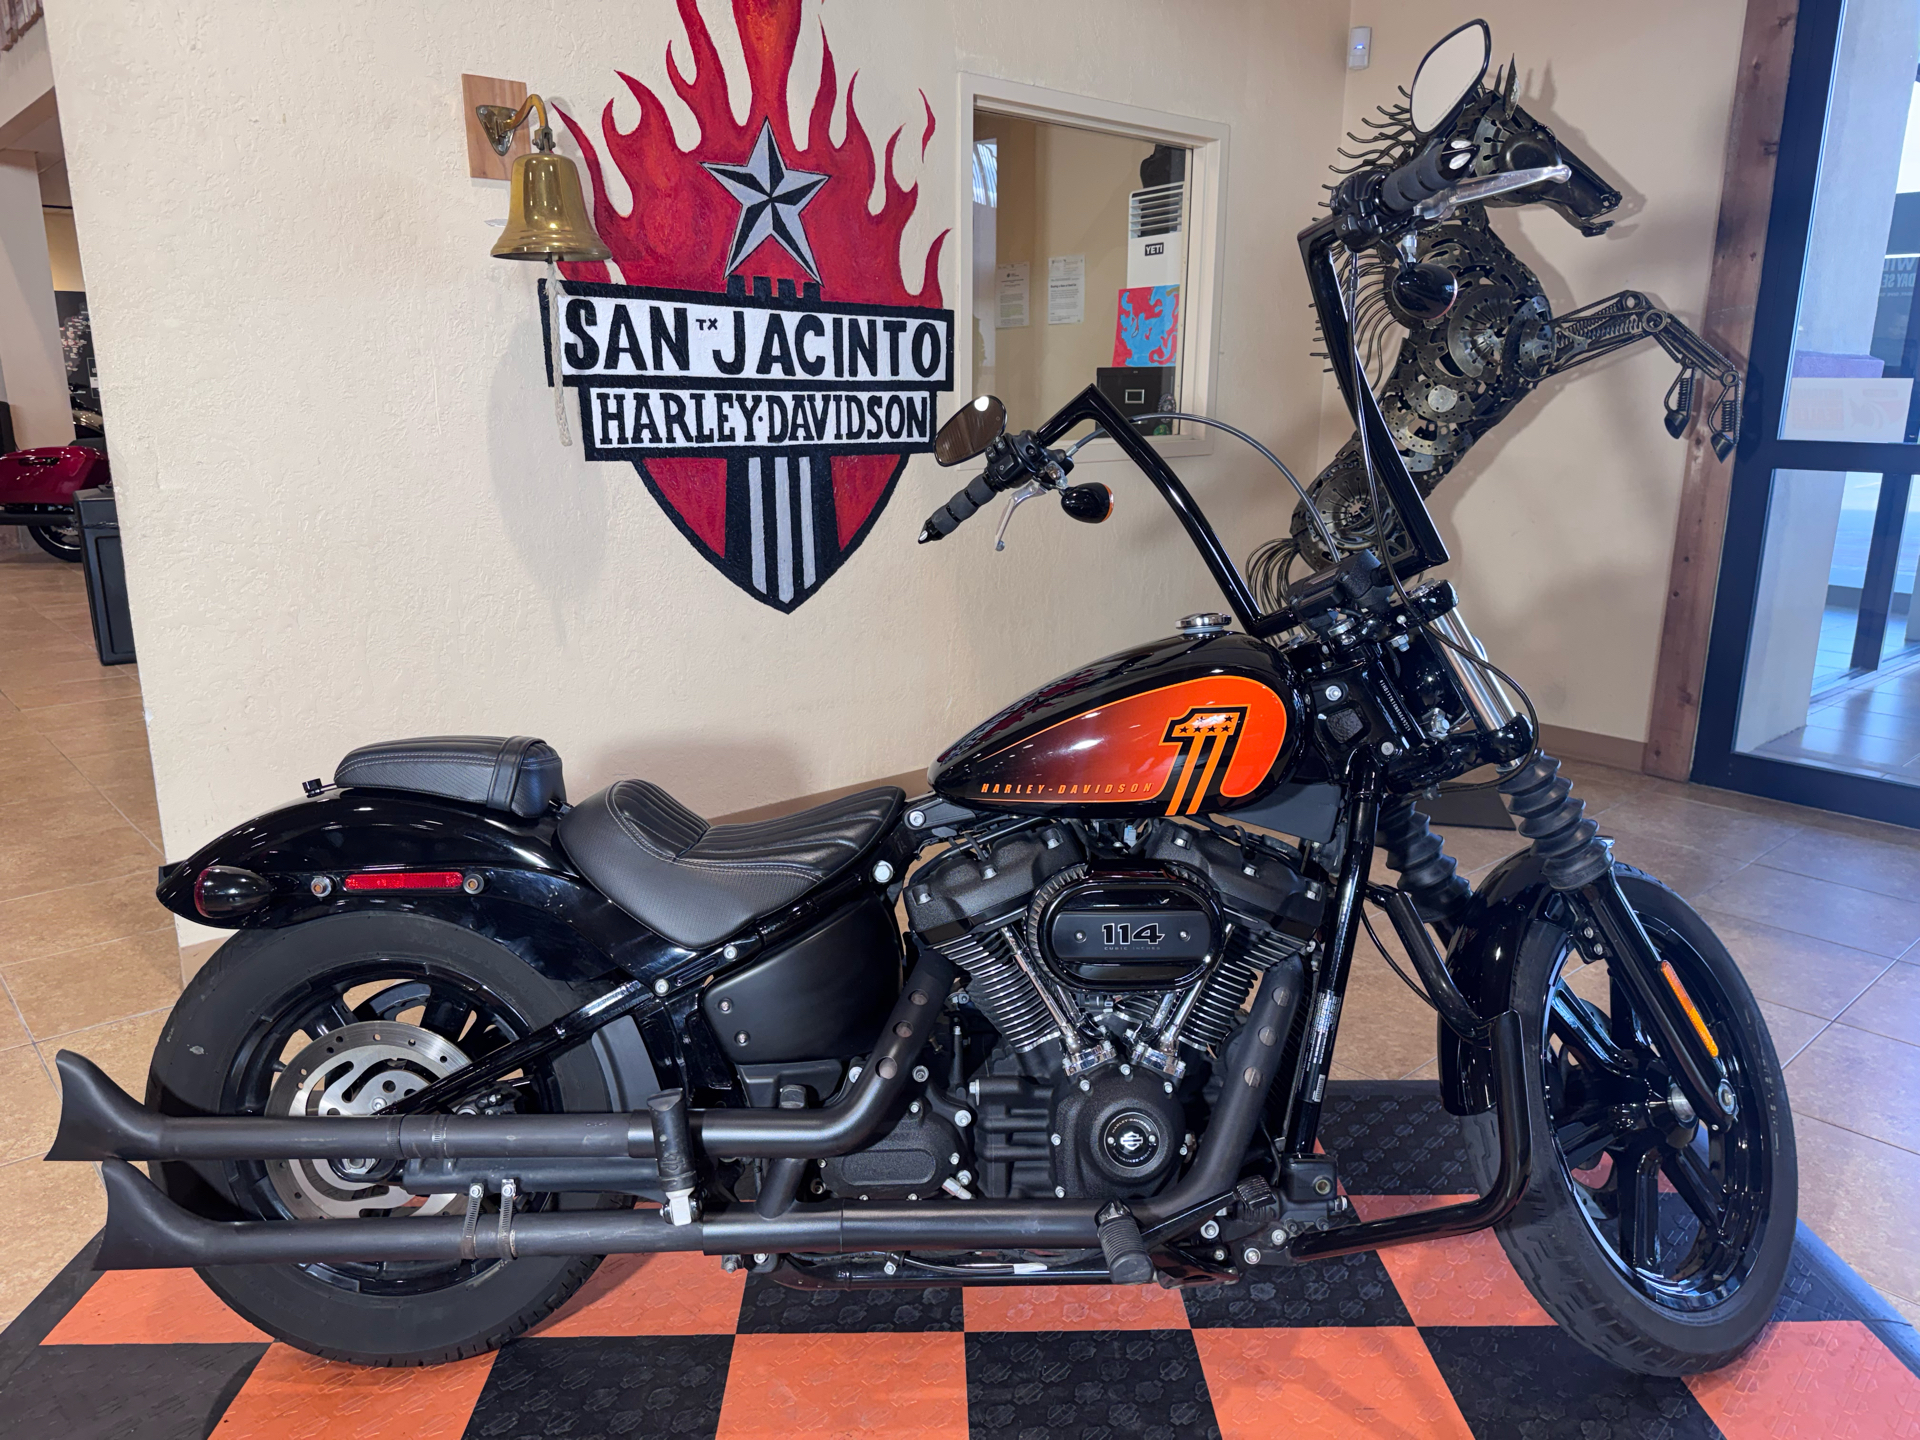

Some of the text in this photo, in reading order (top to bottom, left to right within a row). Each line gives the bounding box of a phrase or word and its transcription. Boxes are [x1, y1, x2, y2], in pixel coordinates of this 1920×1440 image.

[1145, 244, 1163, 255] YETI
[564, 298, 941, 378] SAN TX JACINTO
[981, 783, 1153, 794] HARLEY-DAVIDSON
[1101, 922, 1166, 945] 114
